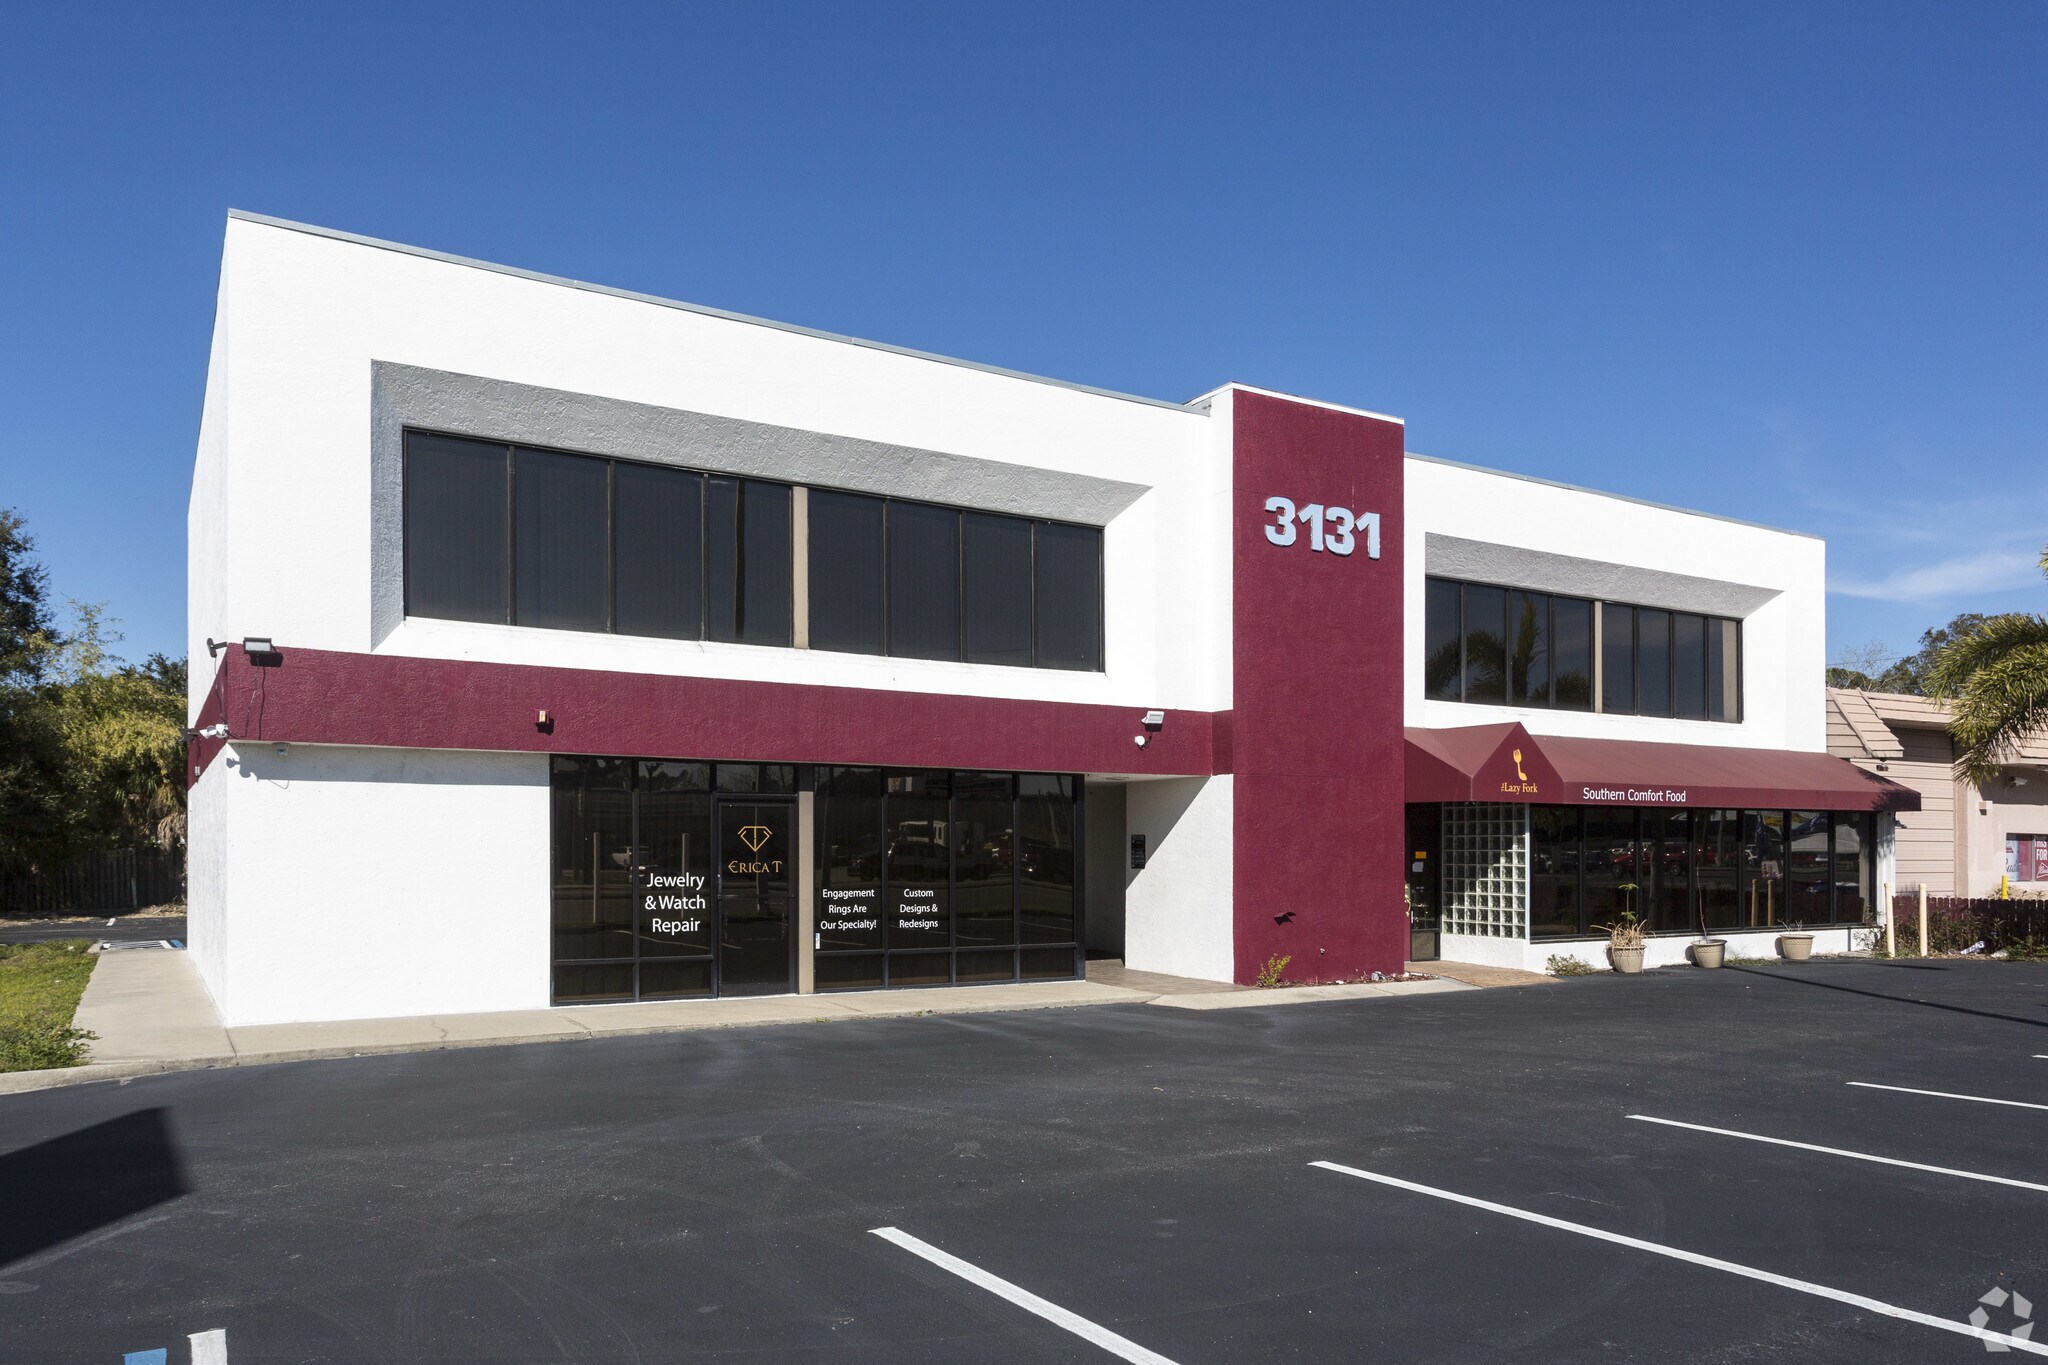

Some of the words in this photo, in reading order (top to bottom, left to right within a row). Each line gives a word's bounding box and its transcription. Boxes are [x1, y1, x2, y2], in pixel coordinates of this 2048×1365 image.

[1264, 496, 1381, 560] 3131
[1504, 782, 1521, 795] Lazy
[1522, 782, 1538, 793] Fork
[1583, 787, 1625, 800] Southern
[1627, 789, 1664, 802] Comfort
[1666, 790, 1687, 802] Food
[2036, 848, 2048, 861] FOR
[728, 860, 770, 873] ERICA
[771, 860, 783, 873] T
[646, 872, 705, 891] Jewelry
[822, 889, 875, 900] Engagement
[903, 889, 934, 898] Custom
[644, 895, 657, 910] &
[658, 894, 706, 910] Watch
[828, 904, 851, 915] Rings
[852, 904, 867, 913] Are
[899, 904, 930, 914] Designs
[931, 904, 938, 912] &
[652, 917, 701, 936] Repair
[820, 921, 836, 930] Our
[837, 920, 877, 931] Specialty!
[899, 919, 939, 930] Redesigns
